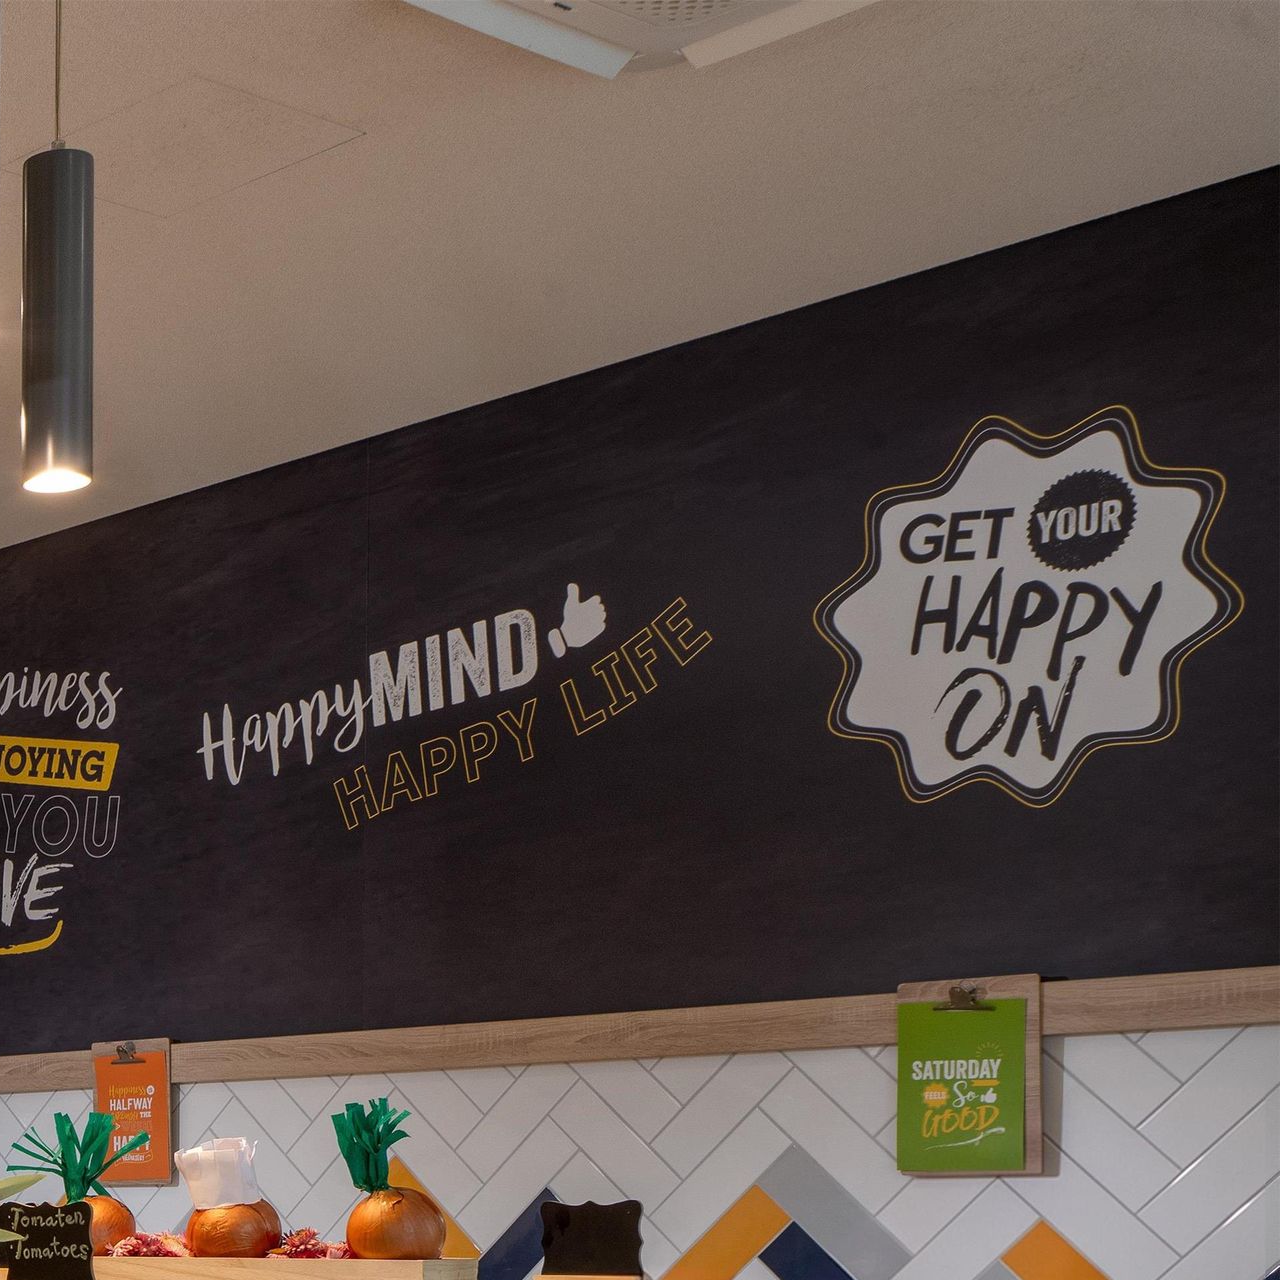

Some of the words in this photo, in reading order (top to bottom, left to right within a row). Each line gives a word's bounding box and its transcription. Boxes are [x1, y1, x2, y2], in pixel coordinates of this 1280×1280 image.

[899, 507, 1015, 564] GET
[1038, 499, 1122, 544] YOUR
[911, 566, 1163, 681] HAPPY
[333, 698, 538, 831] HAPPY
[559, 596, 713, 736] LIFE
[931, 655, 1086, 761] ON
[0, 793, 121, 858] YOU
[911, 1058, 1002, 1080] SATURDAY
[952, 1080, 979, 1108] So
[109, 1097, 153, 1111] HALFWAY
[922, 1104, 1000, 1138] GOOD
